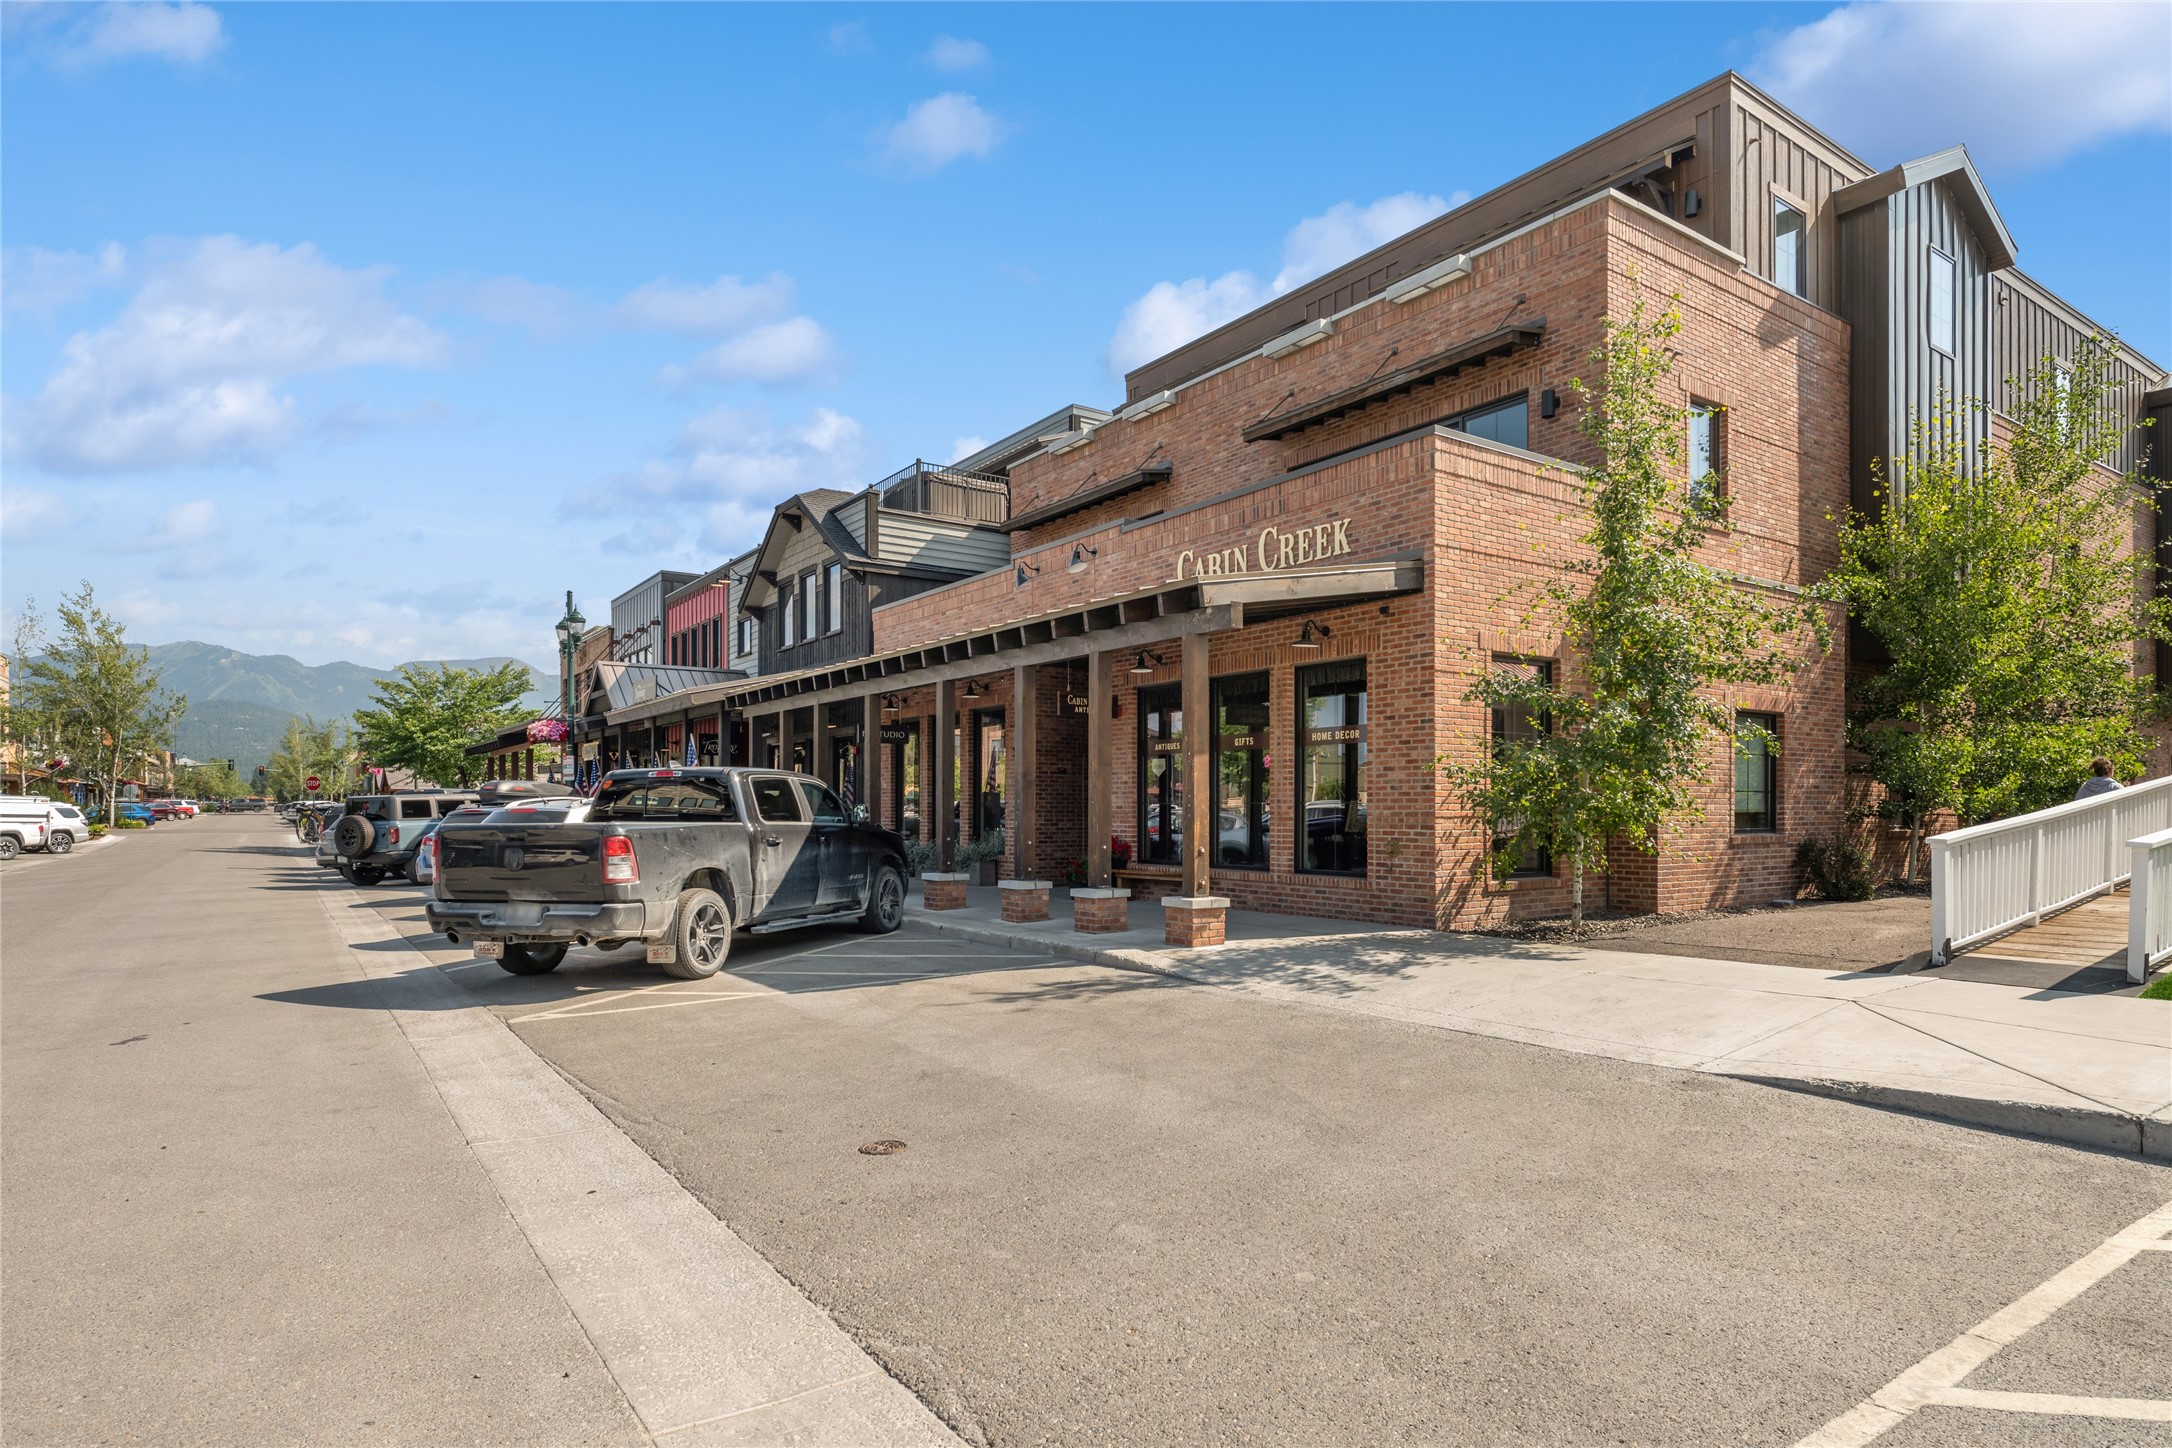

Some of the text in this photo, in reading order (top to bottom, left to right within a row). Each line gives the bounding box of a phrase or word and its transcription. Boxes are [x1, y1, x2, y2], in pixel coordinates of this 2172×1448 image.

[1177, 518, 1352, 581] CABIN CREEK
[1067, 694, 1088, 705] CABIN
[880, 730, 905, 739] TUDIO
[1311, 729, 1360, 742] HOME DECOR
[1154, 742, 1181, 751] ANTIQUES
[1234, 737, 1254, 747] GIFTS
